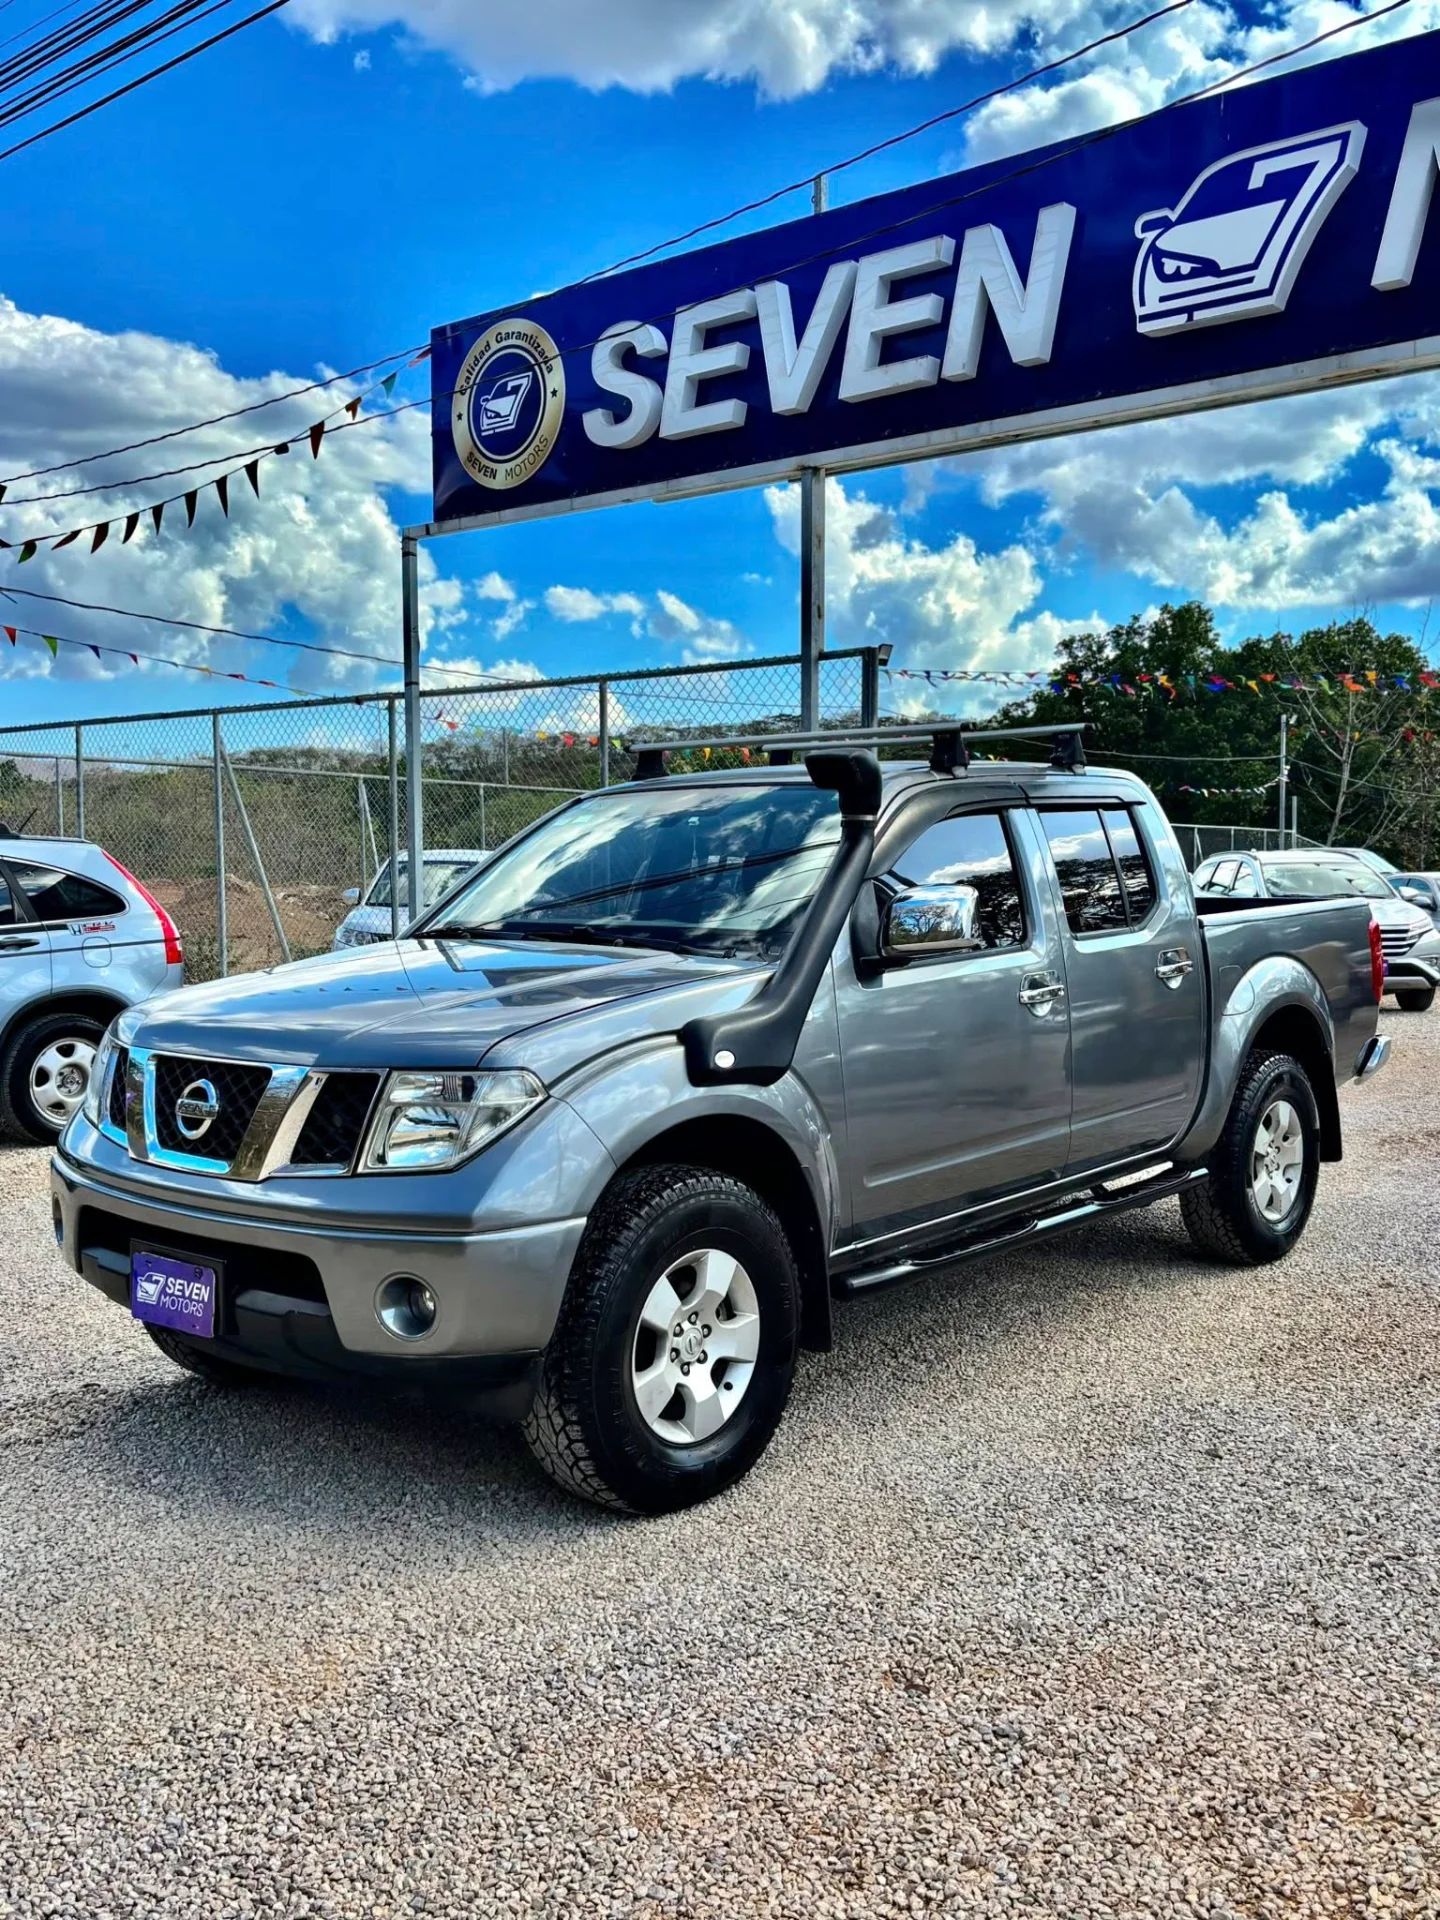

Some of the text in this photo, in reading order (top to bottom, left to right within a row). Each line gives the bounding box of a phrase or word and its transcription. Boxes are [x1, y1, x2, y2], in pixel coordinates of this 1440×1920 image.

[582, 201, 1077, 450] SEVEN
[459, 340, 491, 396] Calidad
[466, 434, 549, 481] SEVEN MOTORS
[160, 1294, 204, 1317] MOTORS
[165, 1277, 210, 1302] SEVEN
